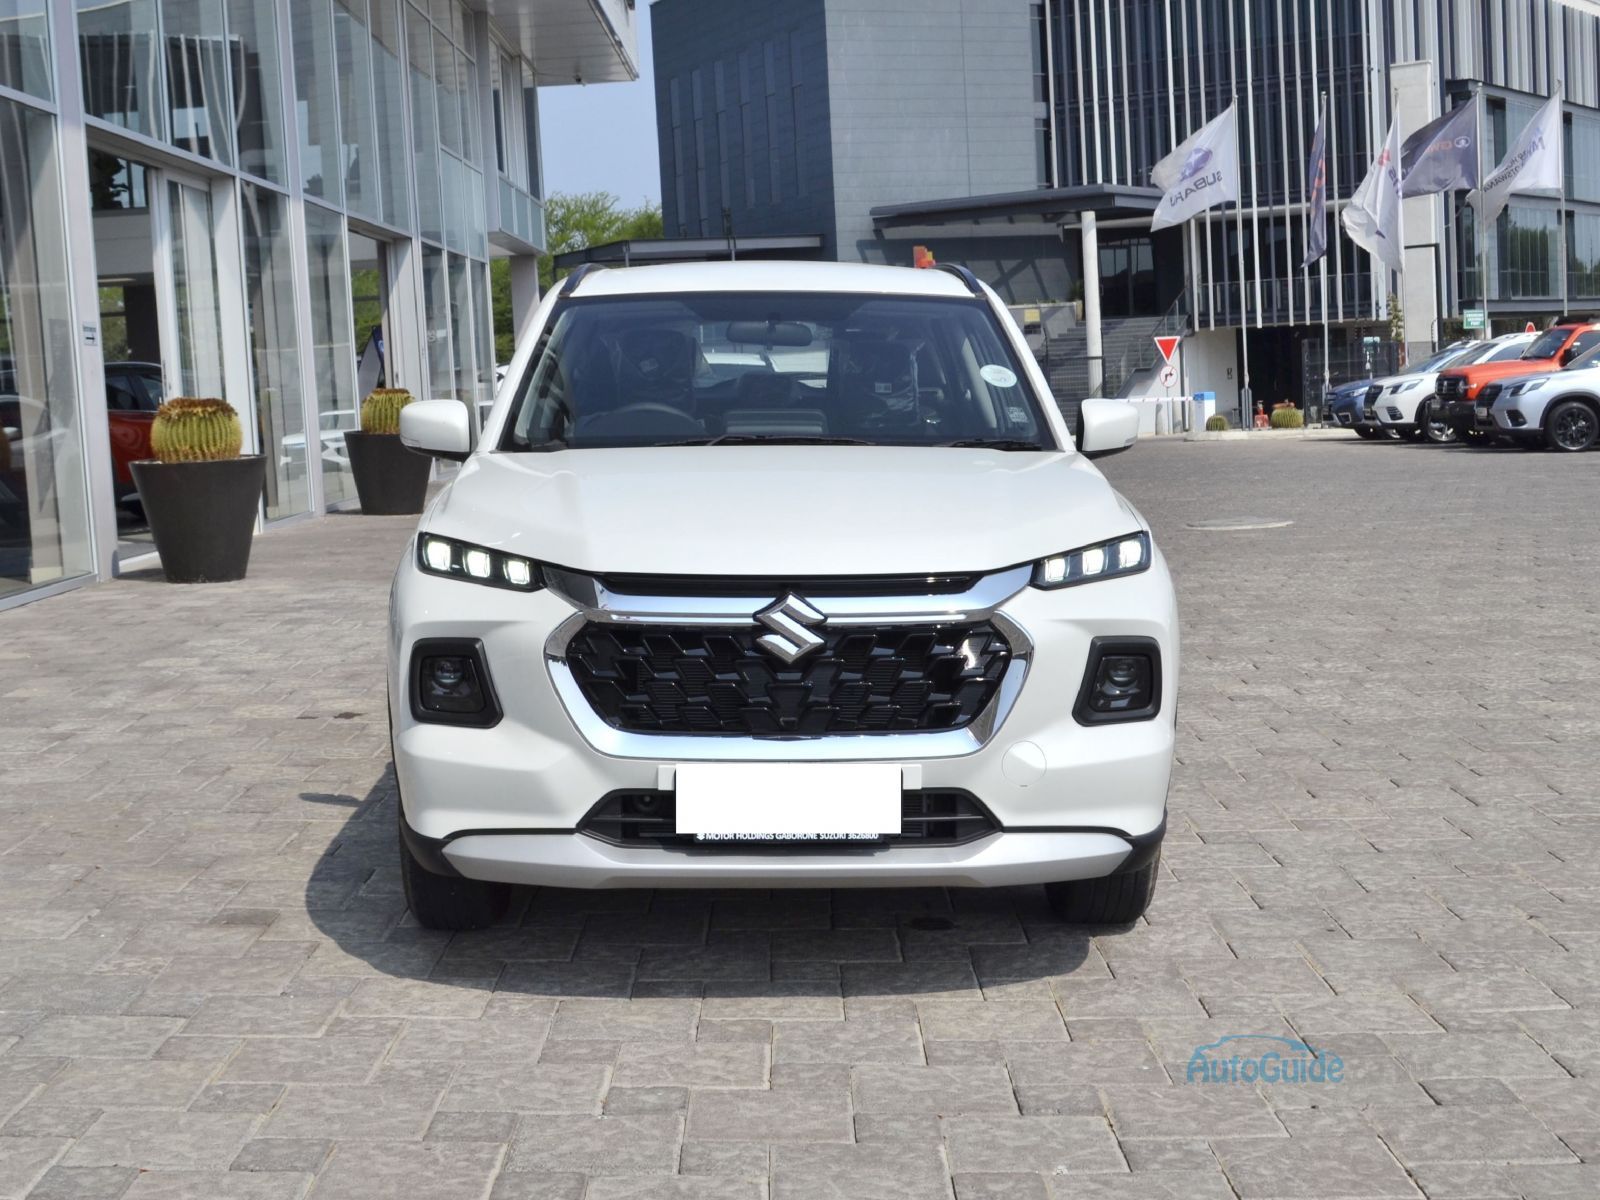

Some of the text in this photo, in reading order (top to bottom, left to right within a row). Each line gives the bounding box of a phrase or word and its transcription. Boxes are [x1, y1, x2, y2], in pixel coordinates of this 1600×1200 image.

[705, 832, 735, 840] MOTOR
[736, 832, 774, 840] HOLDINGS
[775, 832, 818, 840] GABORONE
[820, 832, 847, 840] SUZUKI
